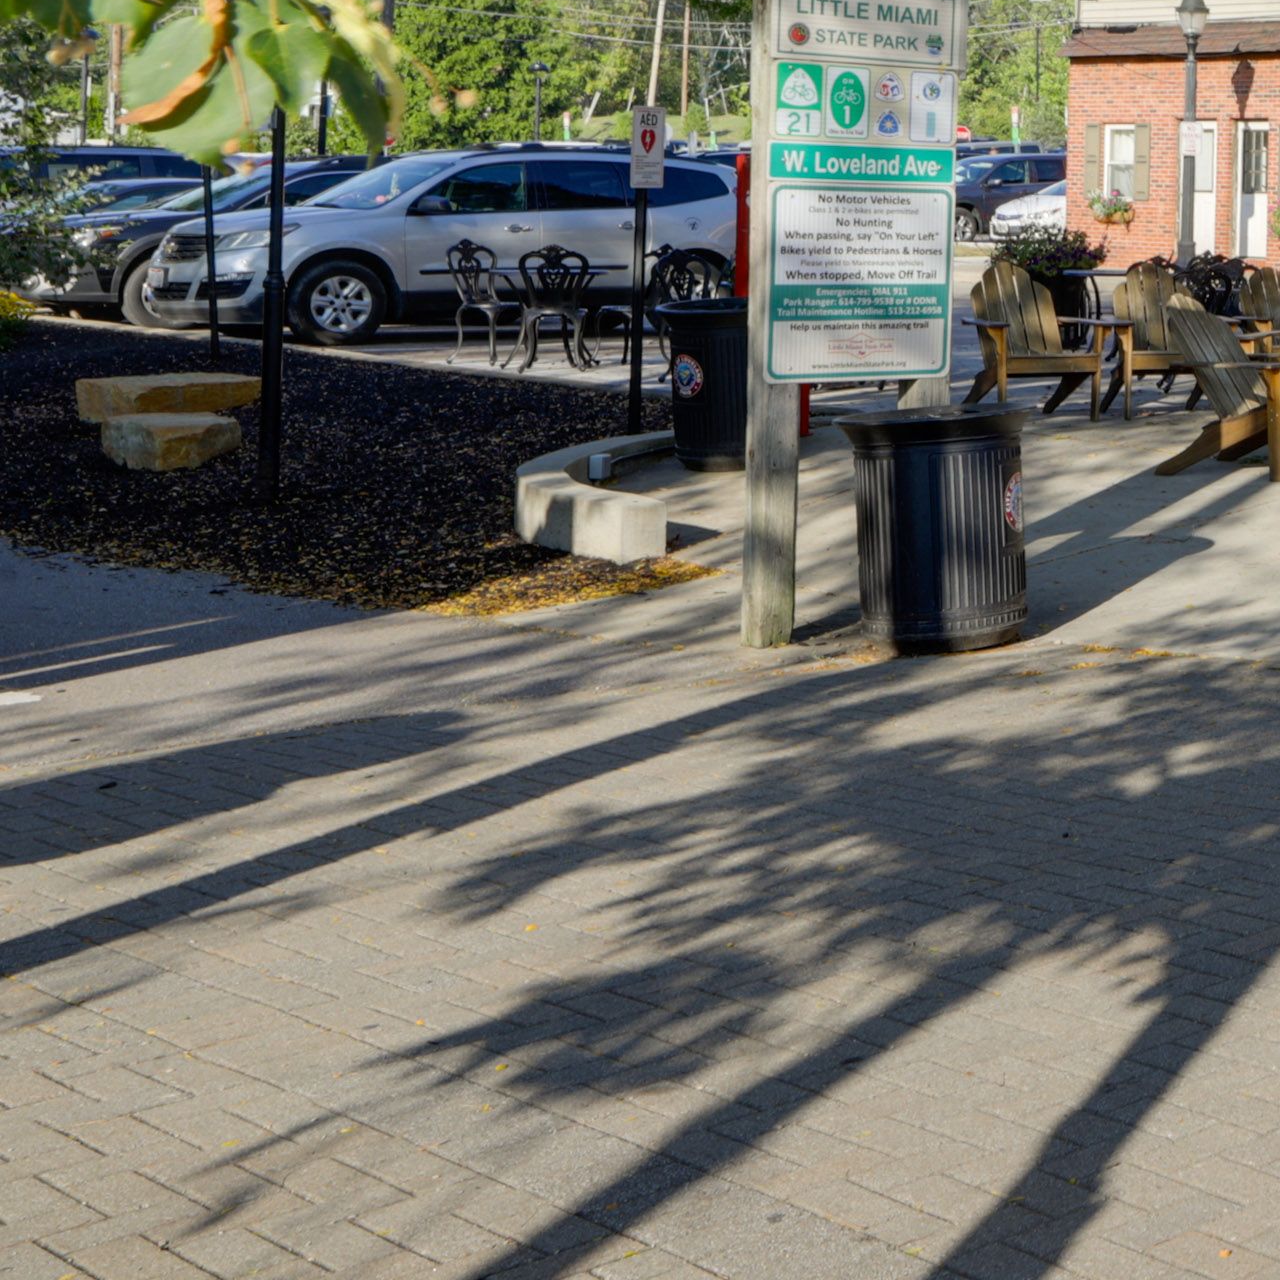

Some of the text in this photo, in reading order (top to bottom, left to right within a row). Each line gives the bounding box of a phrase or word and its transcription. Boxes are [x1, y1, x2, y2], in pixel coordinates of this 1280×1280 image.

[877, 4, 938, 26] MIAMI
[815, 28, 919, 51] STATE PARK
[640, 113, 658, 126] AED
[843, 105, 851, 125] 1
[787, 112, 811, 133] 21
[783, 150, 938, 176] W. Loveland Ave
[818, 194, 911, 205] No Motor Vehicles
[836, 217, 893, 230] No Hunting
[785, 230, 814, 240] When
[816, 231, 854, 242] passing,
[857, 232, 872, 242] say
[895, 232, 916, 241] Your
[918, 231, 939, 241] Left"
[780, 245, 943, 256] Bikes yield to Pedestrians & Horses
[785, 269, 937, 281] When stopped, Move Off Trail
[783, 297, 802, 306] Park
[790, 323, 810, 332] Help
[878, 322, 912, 331] amazing
